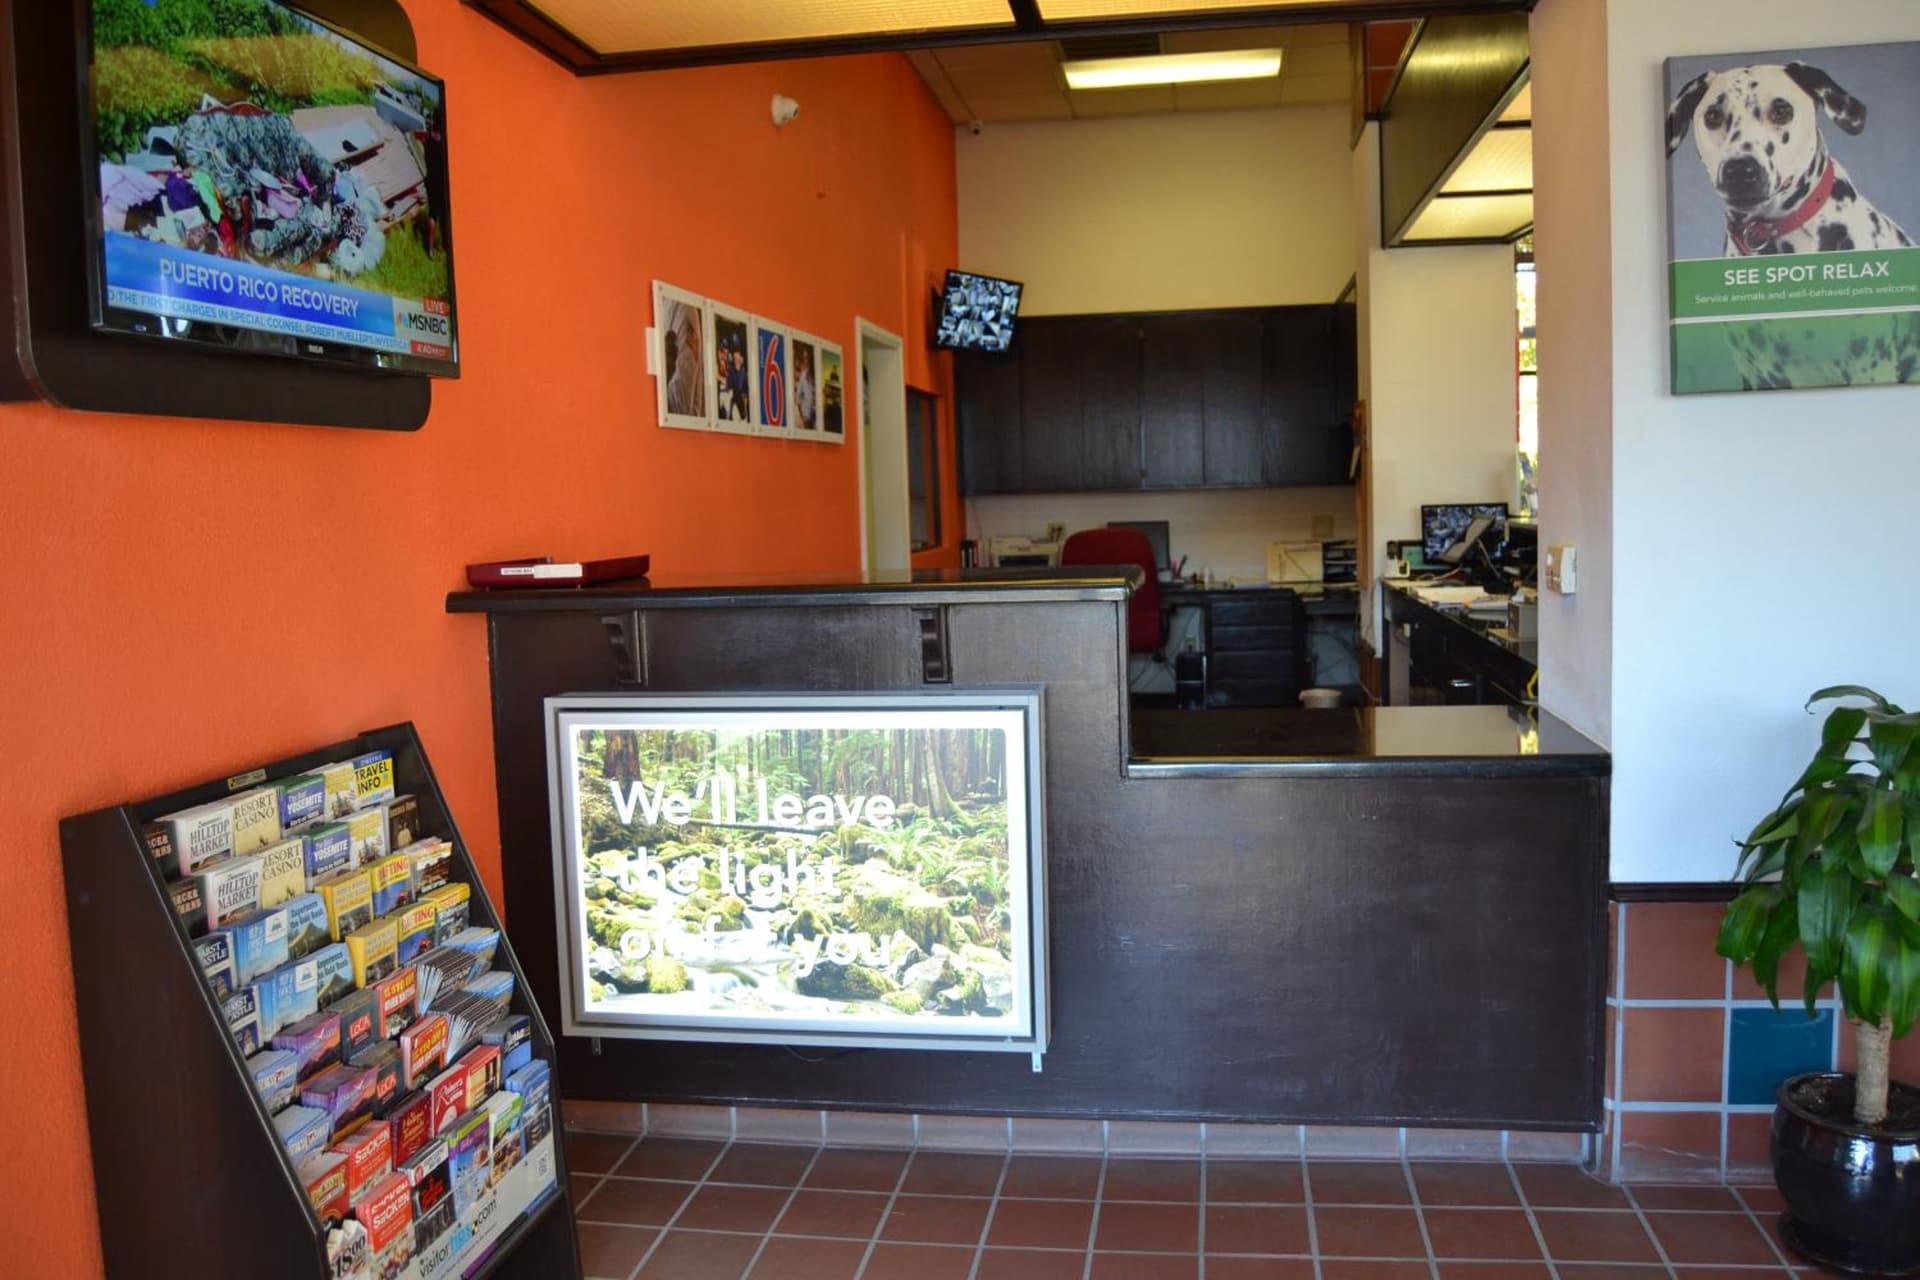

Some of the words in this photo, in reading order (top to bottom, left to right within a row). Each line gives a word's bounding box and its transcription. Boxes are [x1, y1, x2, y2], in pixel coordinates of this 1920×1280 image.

[1724, 268, 1760, 286] SEE
[1766, 265, 1817, 284] SPOT
[1823, 261, 1890, 280] RELAX
[160, 258, 234, 294] PUERTO
[238, 275, 279, 303] RICO
[281, 285, 359, 319] RECOVERY
[1695, 293, 1729, 305] Service
[1731, 291, 1765, 303] animals
[1768, 289, 1786, 301] and
[1852, 285, 1874, 298] pets
[408, 312, 448, 336] MSNBC
[763, 334, 785, 428] 6
[355, 760, 389, 780] TRAVEL
[358, 776, 381, 795] INFO
[234, 793, 273, 819] RESORT
[610, 773, 736, 826] We'll
[758, 778, 897, 828] leave
[189, 818, 230, 845] HILLTOP
[235, 807, 275, 832] CASINO
[189, 832, 231, 859] MARKET
[262, 856, 303, 882] CASINO
[618, 846, 700, 895] the
[719, 847, 841, 908] light
[217, 871, 259, 898] HILLTOP
[217, 884, 259, 910] MARKET
